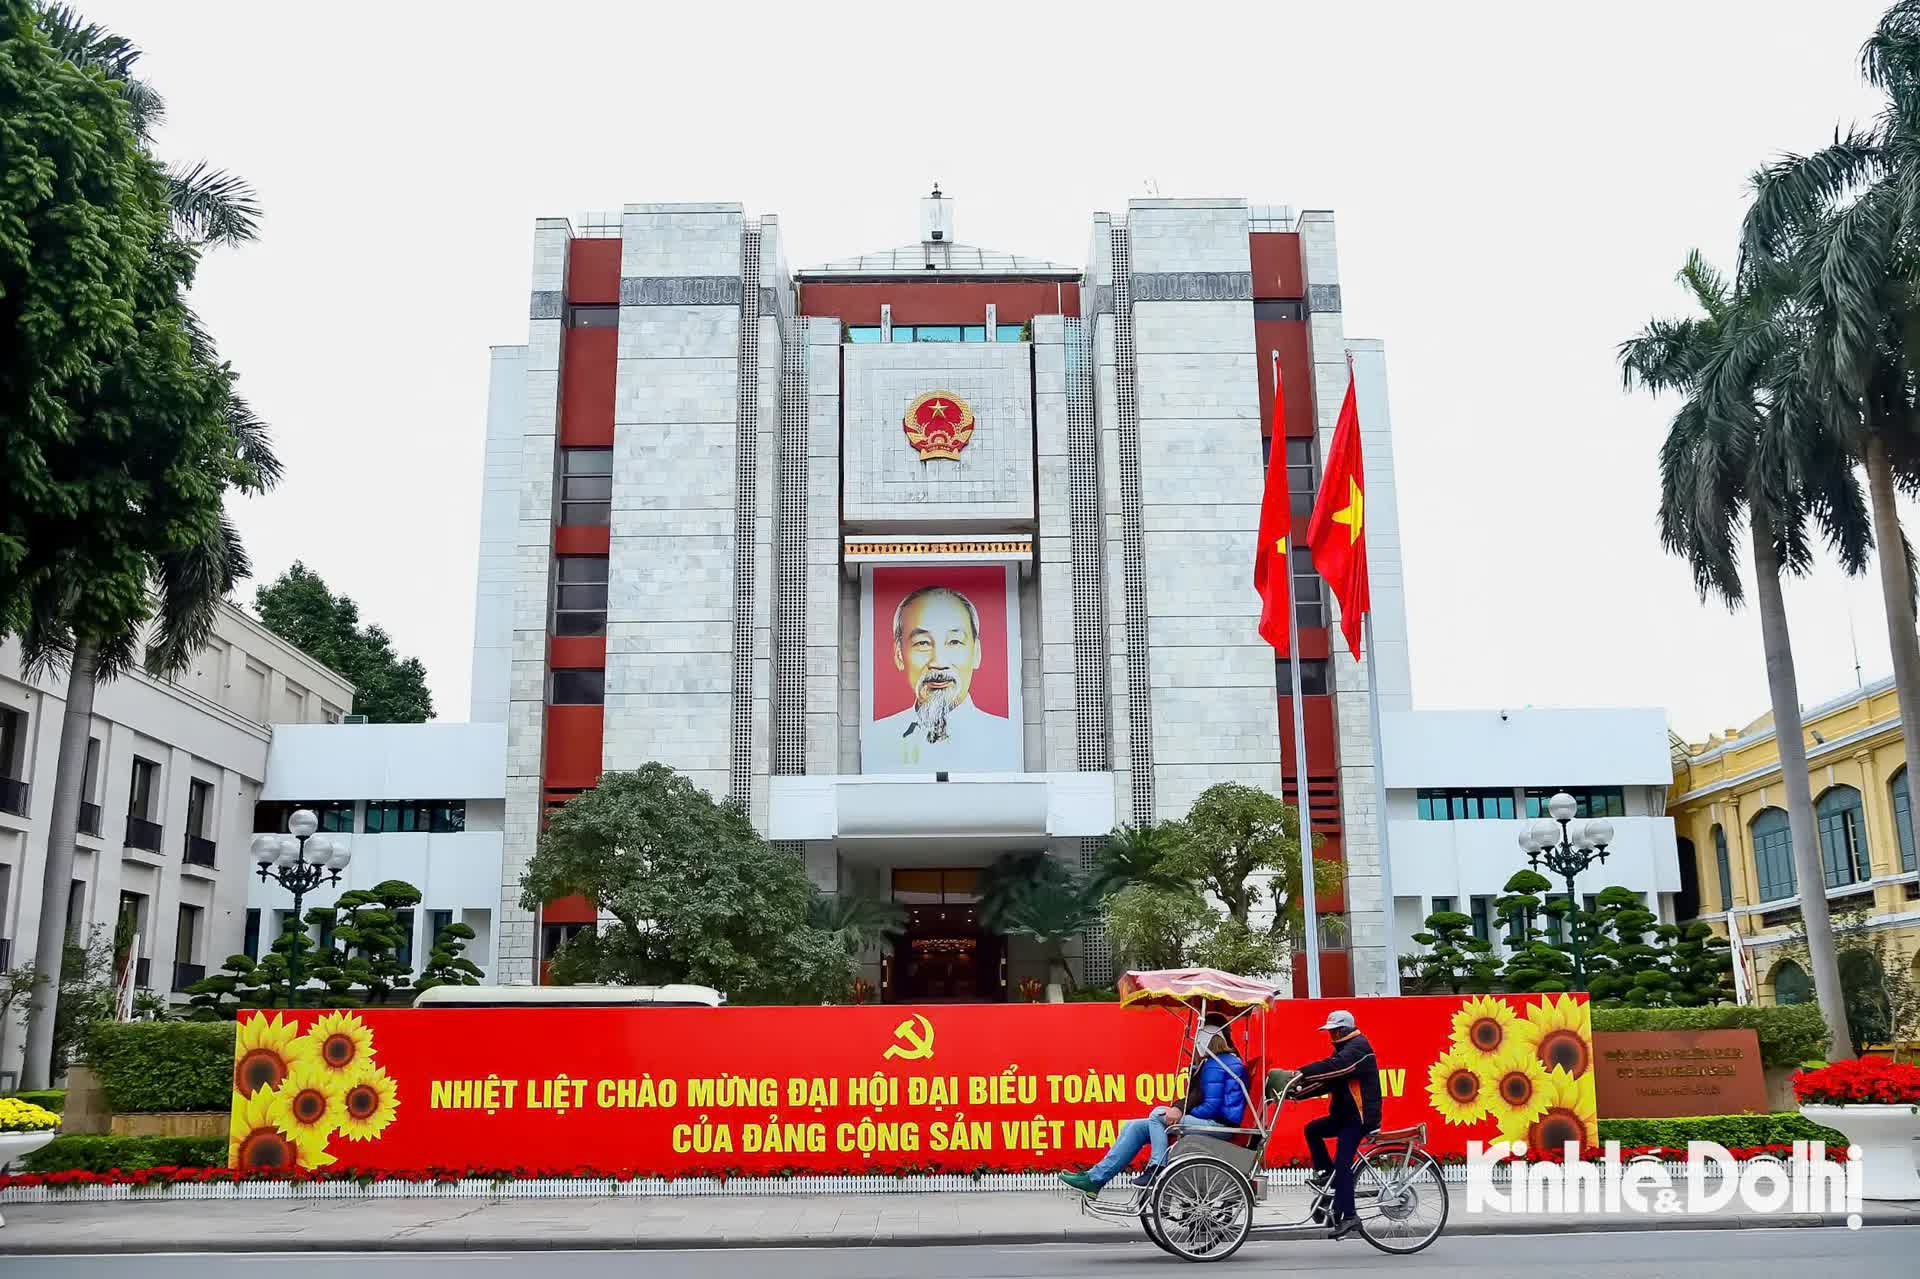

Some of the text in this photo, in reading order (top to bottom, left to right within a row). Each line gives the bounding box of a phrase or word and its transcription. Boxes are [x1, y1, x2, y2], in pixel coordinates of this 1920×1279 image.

[430, 1073, 518, 1115] NHIỆT
[526, 1073, 588, 1115] LIỆT
[596, 1072, 677, 1108] CHÀO
[687, 1072, 778, 1108] MỪNG
[787, 1077, 838, 1113] ĐẠI
[848, 1071, 899, 1113] HỘI
[907, 1076, 959, 1112] ĐẠI
[968, 1064, 1037, 1105] BIỂU
[1046, 1069, 1126, 1104] TOÀN
[672, 1112, 1127, 1159] CỦA ĐẢNG CỘNG SẢN VIỆT NA
